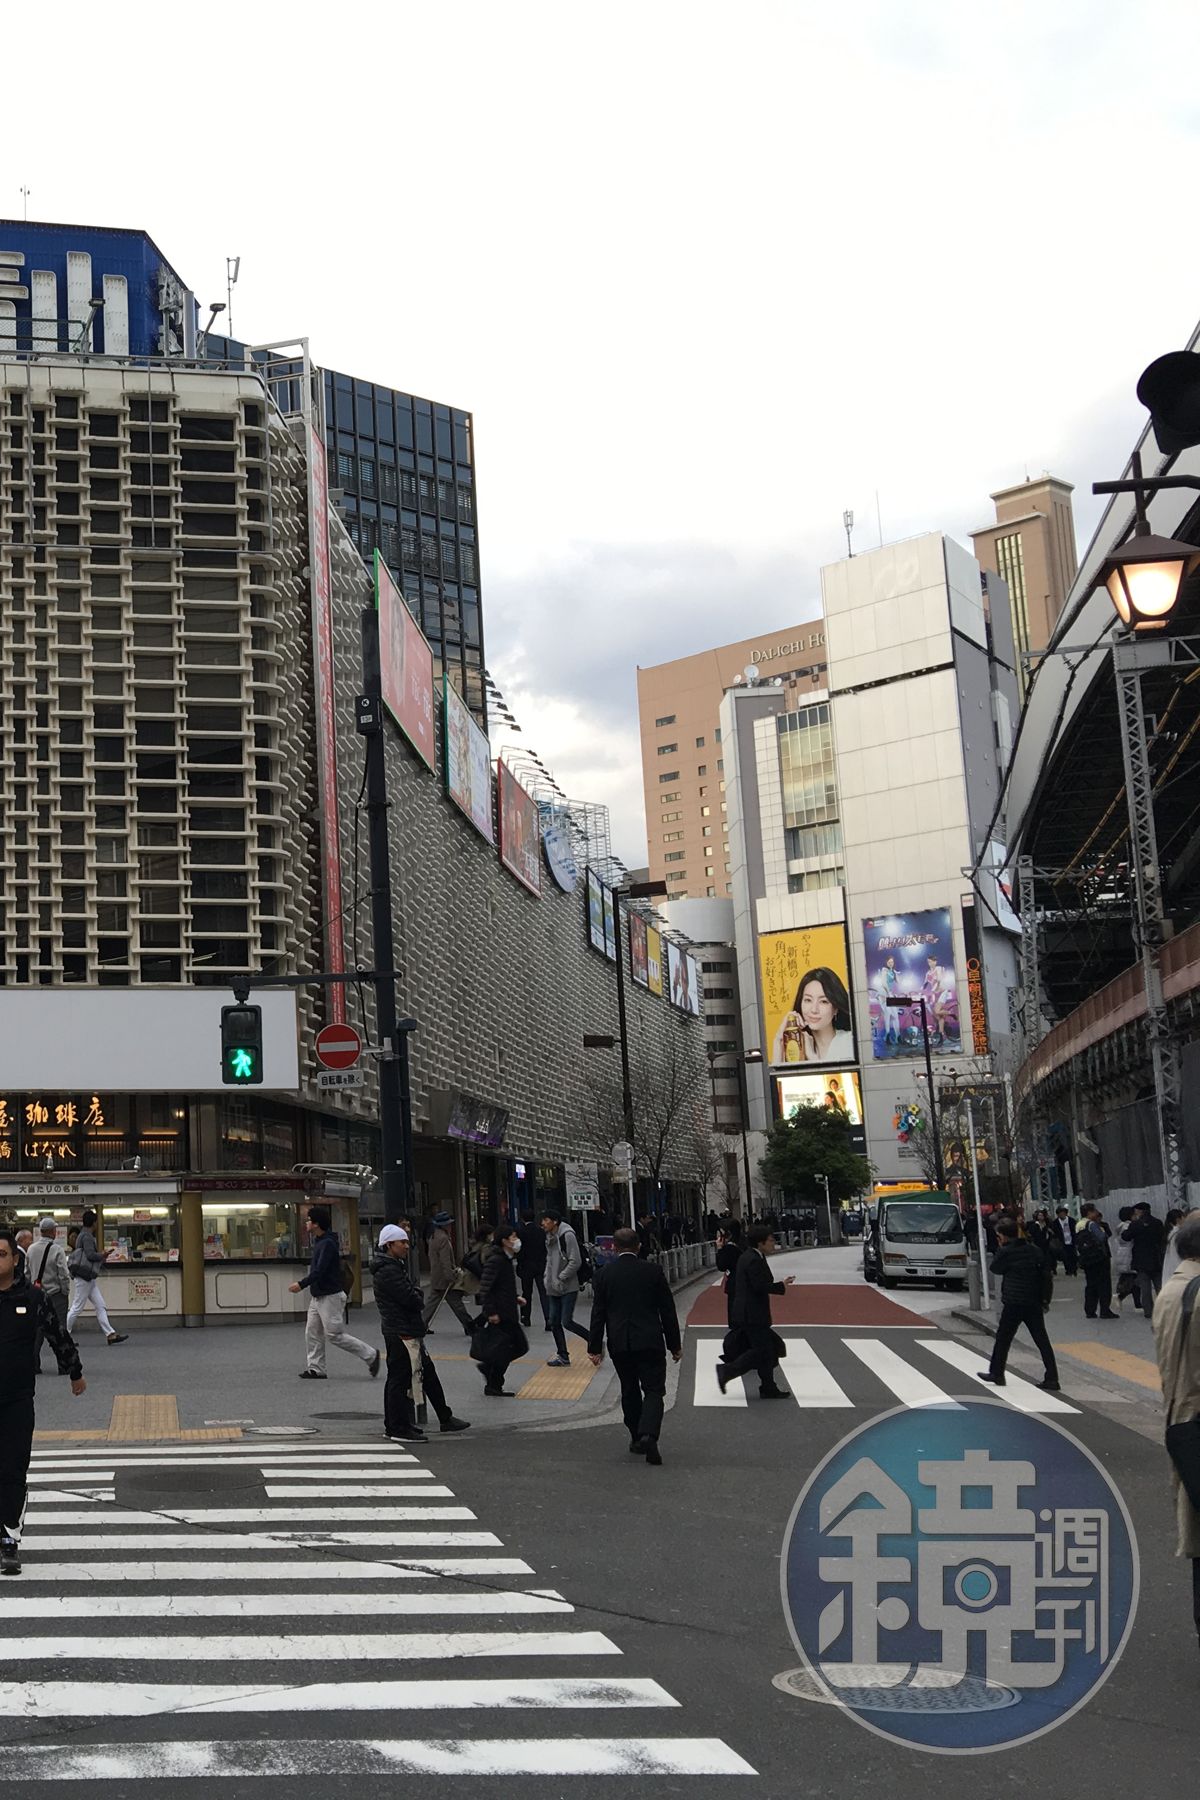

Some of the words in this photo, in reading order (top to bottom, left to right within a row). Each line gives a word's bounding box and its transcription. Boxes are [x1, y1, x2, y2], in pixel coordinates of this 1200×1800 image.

[750, 639, 805, 664] DAI-ICHI
[775, 940, 790, 1003] 角ハイボールが
[787, 945, 799, 978] 新橋の
[25, 1141, 77, 1158] はなれ
[18, 1184, 80, 1194] 大当たりの名所
